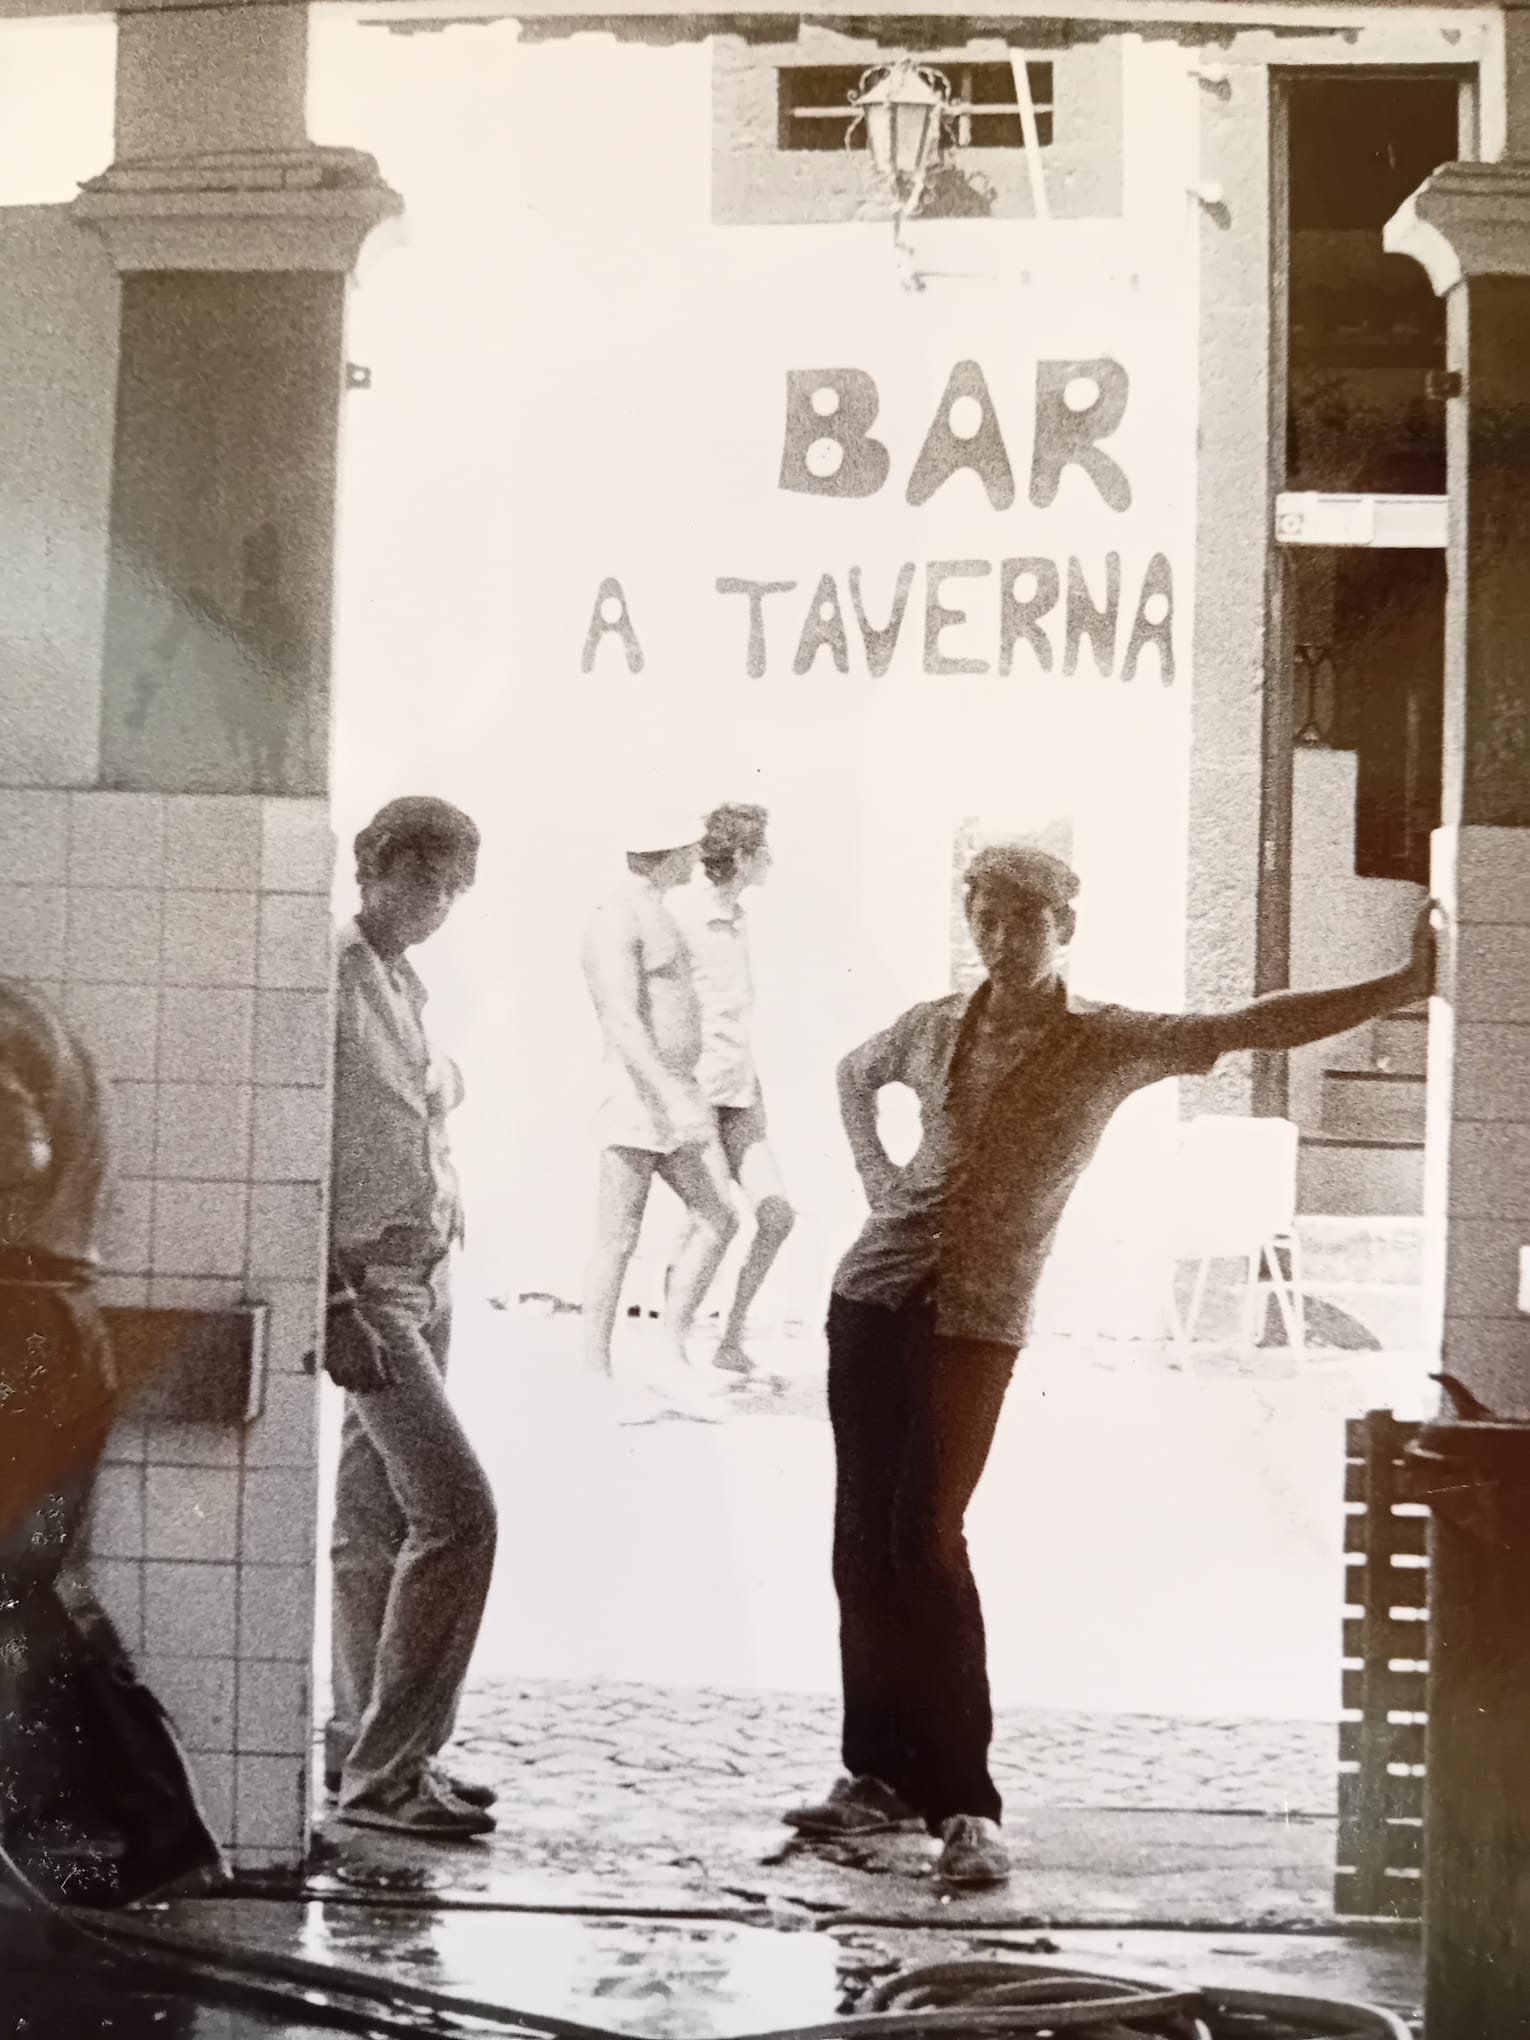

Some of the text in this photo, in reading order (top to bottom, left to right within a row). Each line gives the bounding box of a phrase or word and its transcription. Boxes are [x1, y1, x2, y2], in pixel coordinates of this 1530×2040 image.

[778, 357, 1133, 513] BAR
[581, 550, 1176, 687] A TAVERNA
